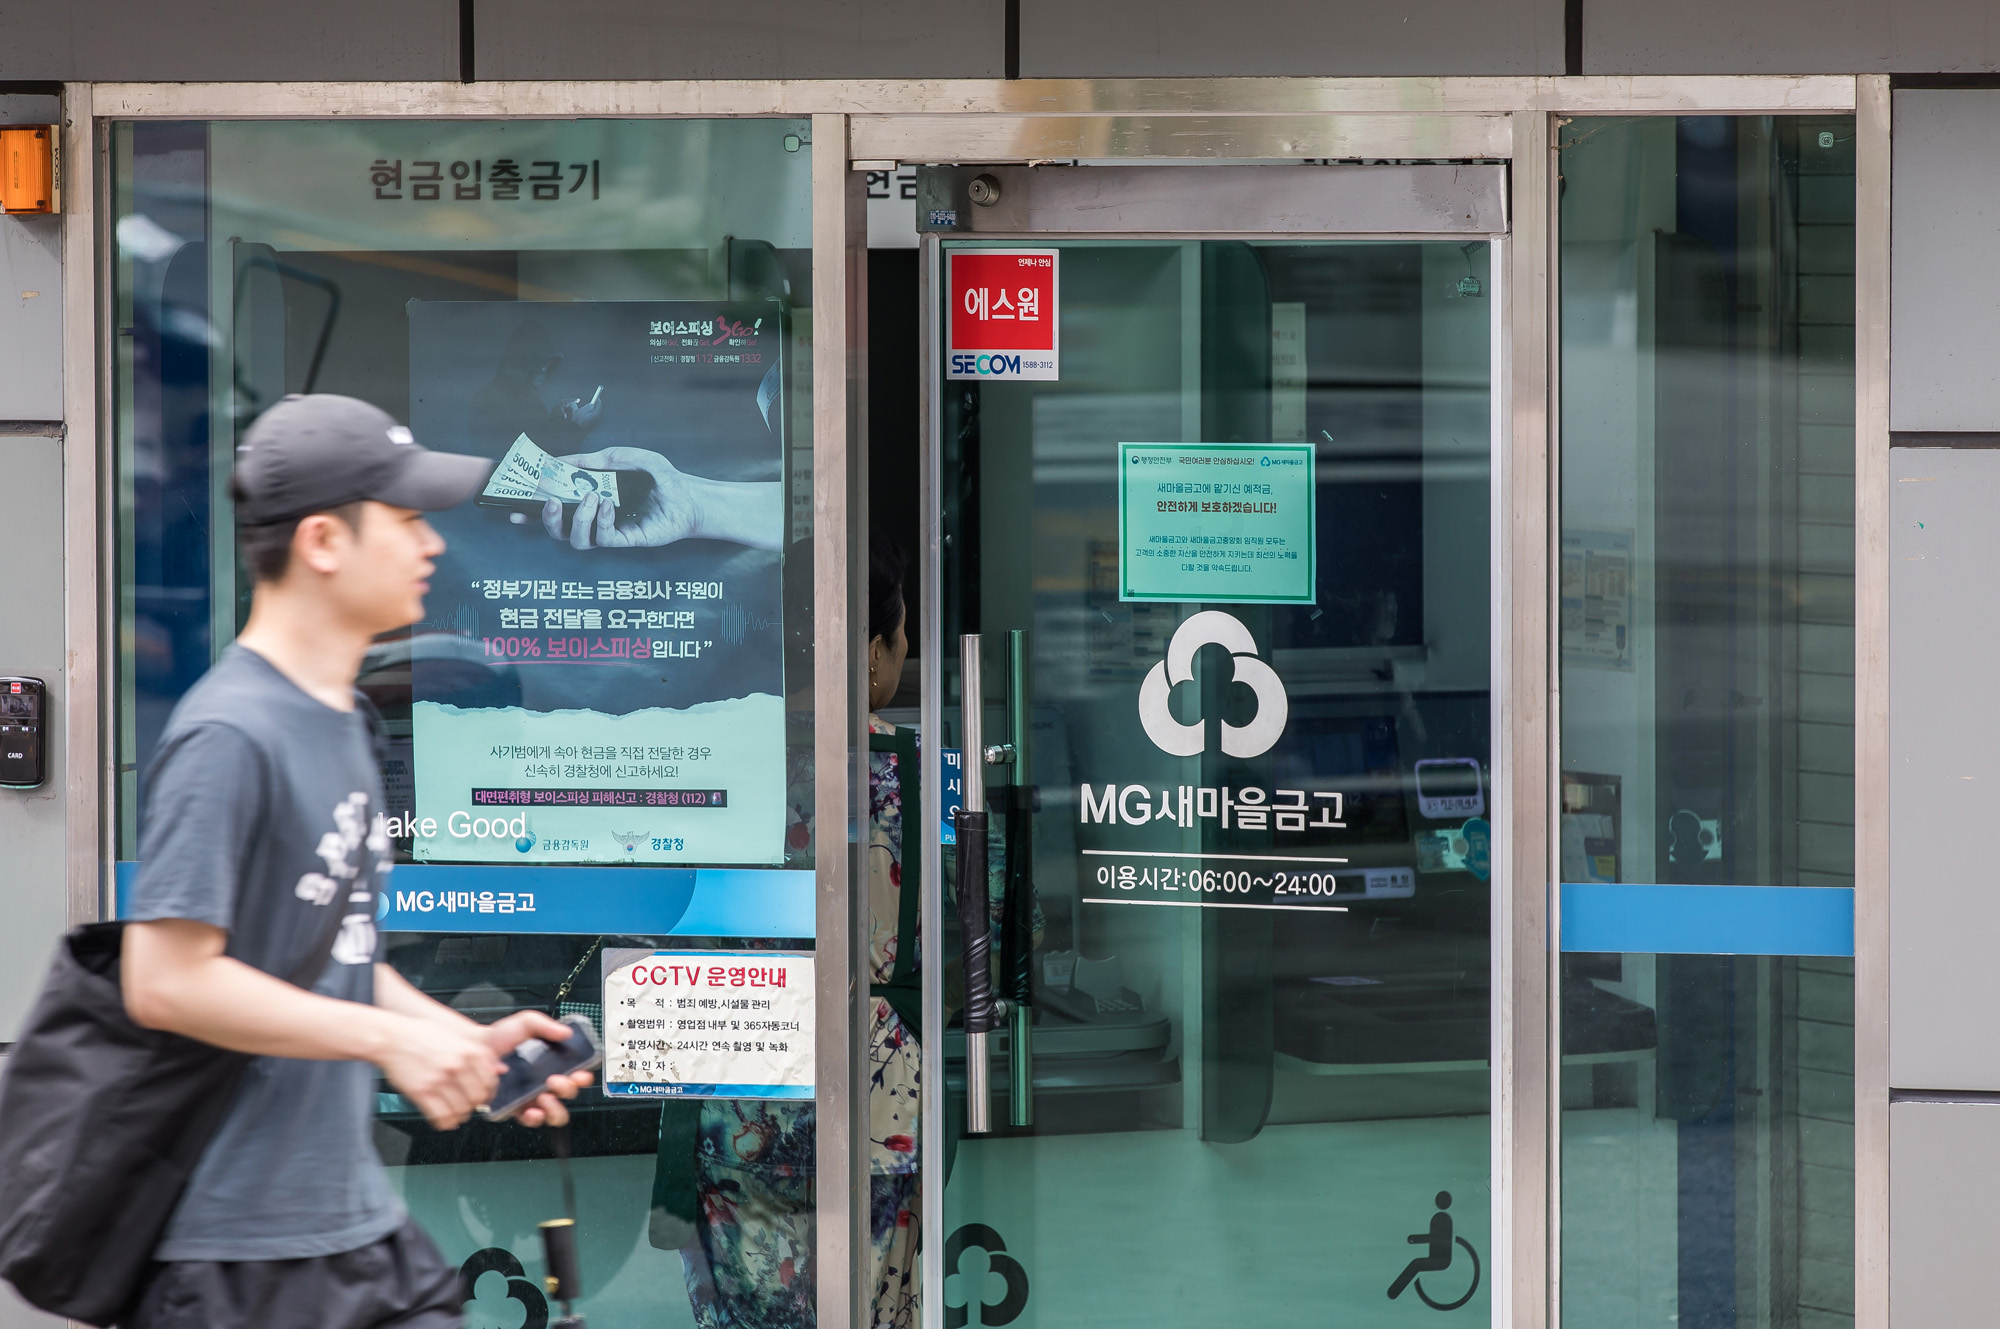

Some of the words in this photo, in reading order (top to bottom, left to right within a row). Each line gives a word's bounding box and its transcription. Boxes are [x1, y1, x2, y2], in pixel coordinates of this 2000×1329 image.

[370, 159, 599, 200] 현금입출금기
[1018, 258, 1037, 267] 언제나
[1038, 258, 1051, 267] 안심
[964, 287, 1039, 321] 에스원
[649, 320, 713, 336] 보이스피싱
[952, 354, 1021, 375] SECOM
[1022, 361, 1053, 369] 1588-3112
[512, 452, 541, 481] 50000
[1140, 456, 1172, 465] 행정안전부
[1178, 457, 1211, 465] 국민여러분
[1213, 457, 1255, 466] 안심하십시오!
[493, 487, 533, 498] 50000
[1157, 483, 1212, 494] 새마을금고에
[1213, 483, 1241, 494] 맡기신
[1243, 484, 1273, 495] 예적금,
[1156, 501, 1198, 513] 안전하게
[1200, 501, 1277, 514] 보호하겠습니다!
[1148, 535, 1188, 544] 새마을금고와
[1189, 536, 1243, 545] 새마을금고중앙회
[1244, 536, 1264, 545] 임직원
[1265, 537, 1286, 546] 모두는
[1135, 549, 1155, 558] 고객의
[1156, 549, 1176, 558] 소중한
[1178, 549, 1198, 559] 자산을
[1199, 549, 1227, 559] 안전하게
[1227, 550, 1254, 559] 지키는데
[1255, 550, 1276, 560] 최선의
[1277, 551, 1298, 560] 노력을
[1181, 563, 1195, 572] 다할
[1196, 563, 1210, 572] 것을
[1211, 564, 1253, 573] 약속드립니다.
[561, 581, 594, 600] 또는
[597, 580, 672, 600] 금융회사
[675, 581, 724, 600] 직원이
[499, 608, 539, 629] 현금
[543, 608, 603, 630] 전달을
[607, 608, 695, 630] 요구한다면
[482, 637, 542, 657] 100%
[489, 745, 551, 759] 사기범에게
[553, 745, 578, 760] 속아
[580, 745, 617, 760] 현금을
[620, 745, 645, 760] 직접
[647, 746, 685, 760] 전달한
[687, 746, 712, 760] 경우
[524, 763, 560, 779] 신속히
[563, 764, 612, 779] 경찰청에
[615, 765, 679, 779] 신고하세요!
[475, 790, 531, 804] 대면편취형
[533, 791, 590, 805] 보이스피싱
[592, 791, 637, 805] 피해신고
[645, 791, 679, 805] 경찰청
[681, 791, 706, 805] (112)
[1081, 783, 1347, 831] MG새마을금고
[448, 811, 526, 838] Good
[542, 839, 589, 851] 금융감독원
[651, 837, 684, 851] 경찰청
[631, 965, 701, 986] CCTV
[707, 967, 787, 988] 운영안내
[676, 998, 696, 1009] 범죄
[751, 999, 771, 1010] 관리
[626, 1019, 665, 1030] 촬영범위
[677, 1019, 706, 1030] 영업점
[707, 1020, 727, 1030] 내부
[730, 1020, 740, 1031] 및
[743, 1020, 800, 1032] 365자동코너
[627, 1040, 667, 1050] 촬영시간
[676, 1041, 708, 1051] 24시간
[711, 1041, 731, 1051] 연속
[733, 1041, 752, 1052] 촬영
[755, 1041, 765, 1052] 및
[768, 1041, 788, 1052] 녹화
[639, 1085, 683, 1094] MG새마을금고
